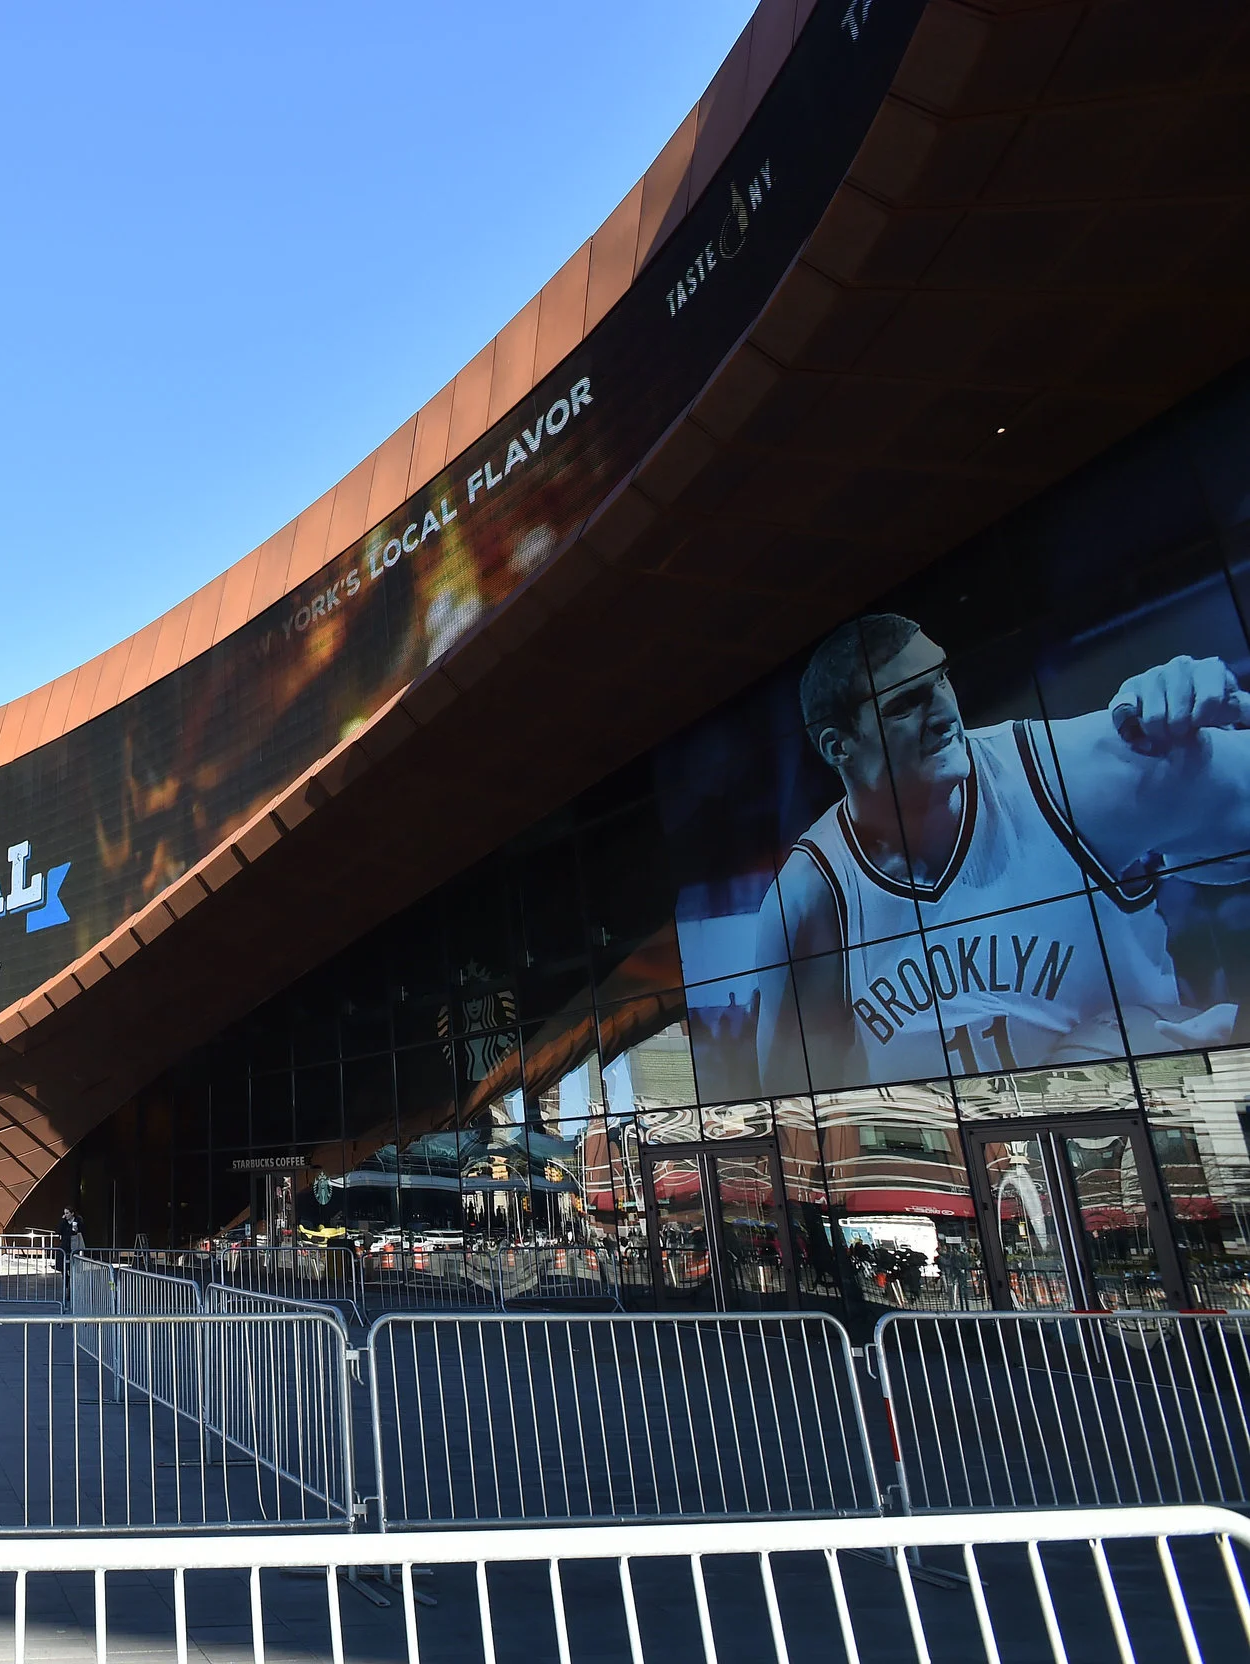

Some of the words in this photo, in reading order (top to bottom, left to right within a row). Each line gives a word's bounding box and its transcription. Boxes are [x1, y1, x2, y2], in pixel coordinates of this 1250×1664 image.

[665, 240, 717, 317] TASTE
[748, 158, 776, 212] NY
[281, 568, 361, 641] YORK'S
[368, 497, 458, 579] LOCAL
[466, 376, 595, 504] FLAVOR
[851, 934, 1075, 1045] BROOKLYN
[946, 1014, 1017, 1076] 11
[232, 1157, 275, 1169] STARBUCKS
[275, 1156, 305, 1167] COFFEE
